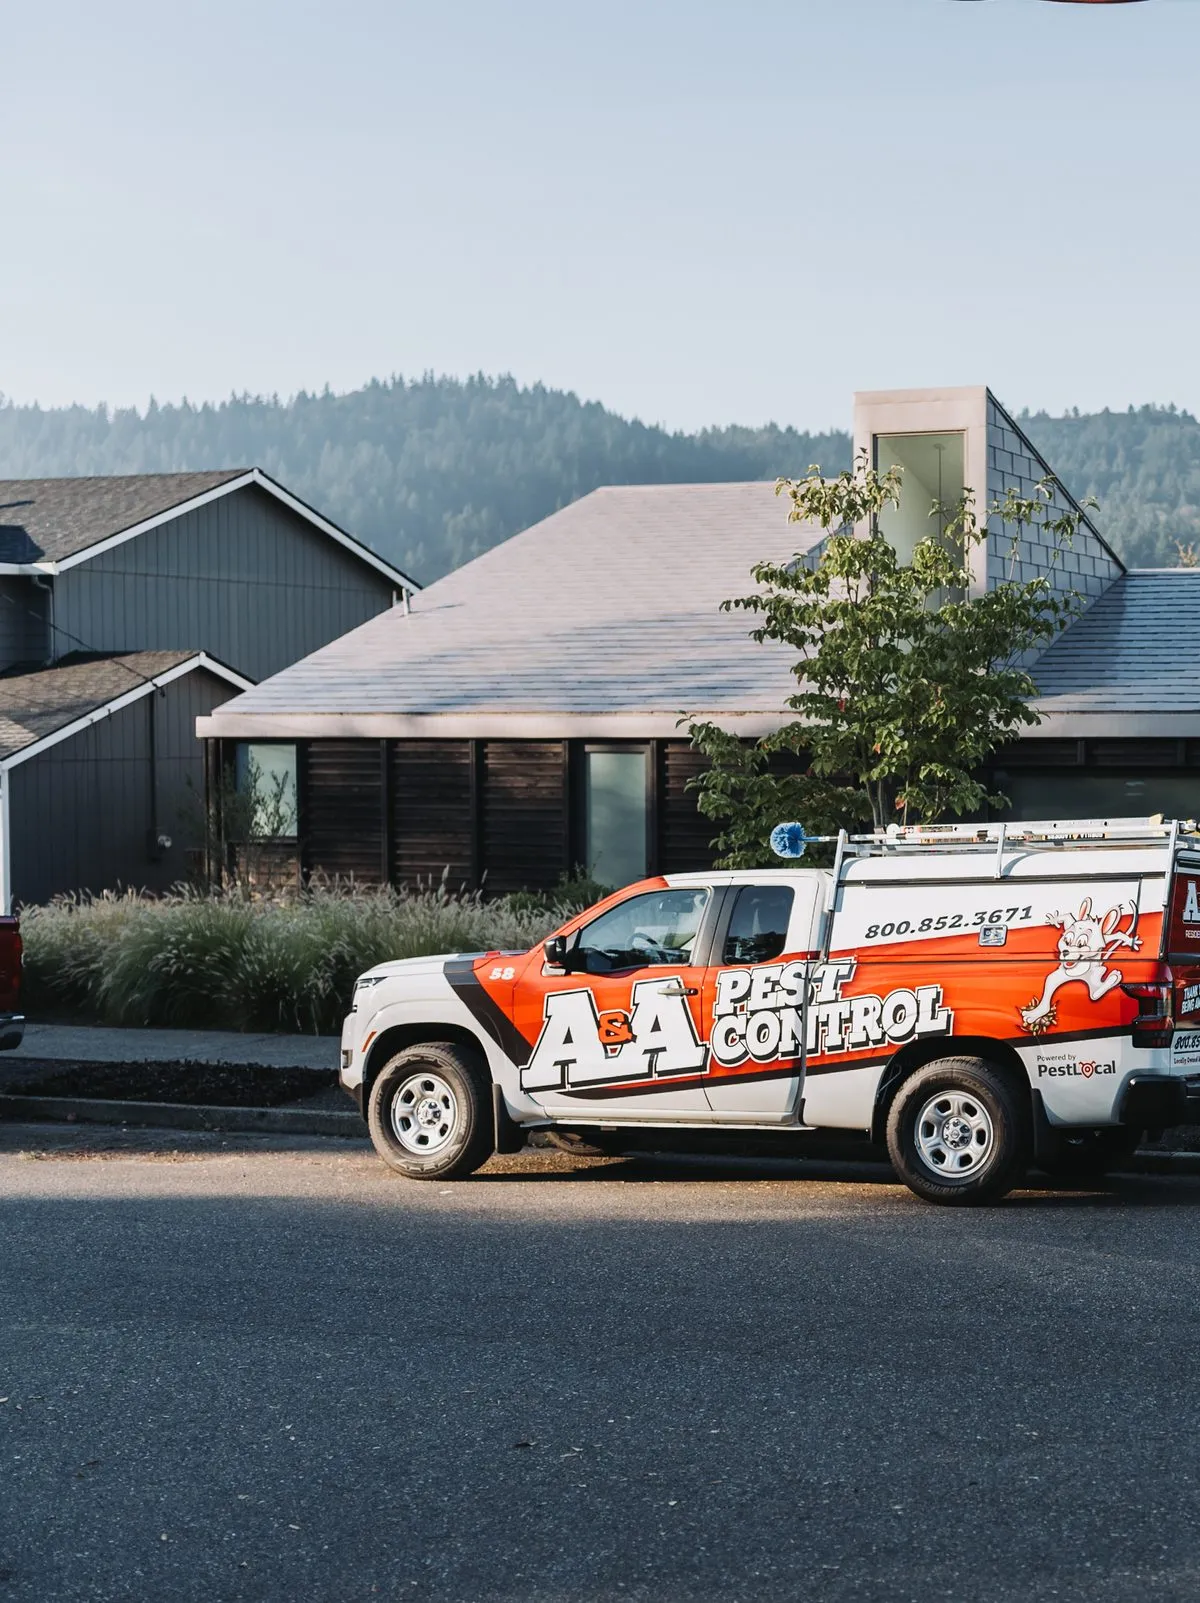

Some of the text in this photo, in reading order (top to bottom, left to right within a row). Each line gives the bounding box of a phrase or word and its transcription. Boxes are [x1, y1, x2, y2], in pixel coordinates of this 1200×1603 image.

[864, 905, 1033, 939] 800.852.3671
[489, 966, 516, 980] 58
[713, 956, 857, 1016] PEST
[711, 984, 954, 1067] CONTROL
[1037, 1060, 1116, 1078] PestLocal
[1067, 1053, 1077, 1061] by
